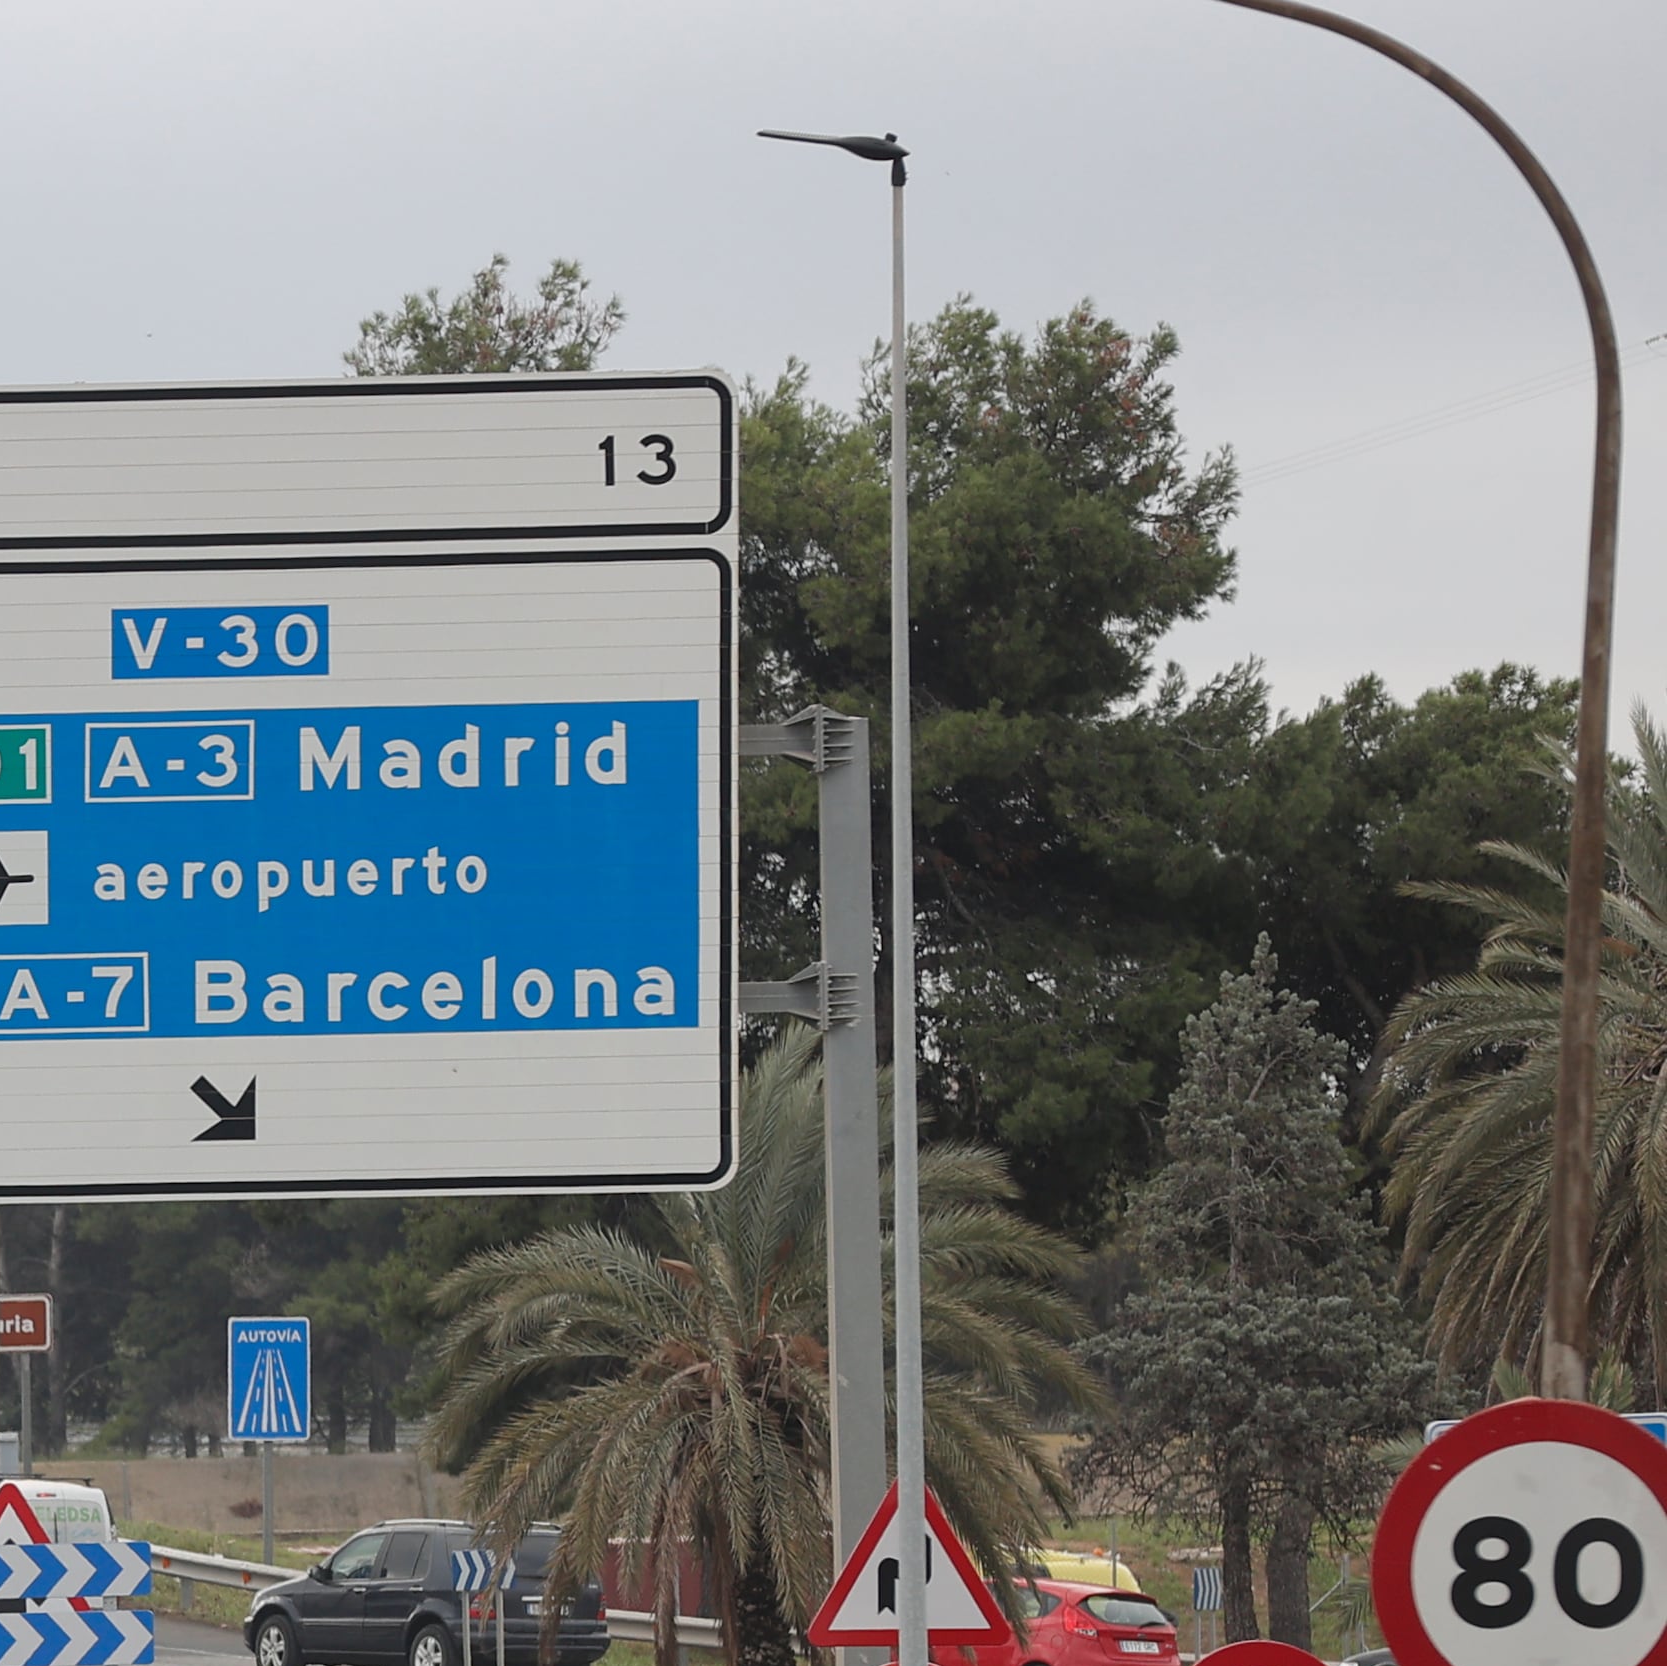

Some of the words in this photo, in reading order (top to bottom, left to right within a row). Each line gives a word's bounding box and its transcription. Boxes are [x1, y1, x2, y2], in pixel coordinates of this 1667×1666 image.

[599, 434, 677, 487] 13
[121, 613, 319, 670] V-30
[99, 735, 240, 788] A-3
[299, 720, 628, 792] Madrid
[93, 846, 489, 913] aeropuerto
[194, 955, 677, 1026] Barcelona
[237, 1328, 302, 1343] AUTOVÍA
[1450, 1515, 1645, 1630] 80
